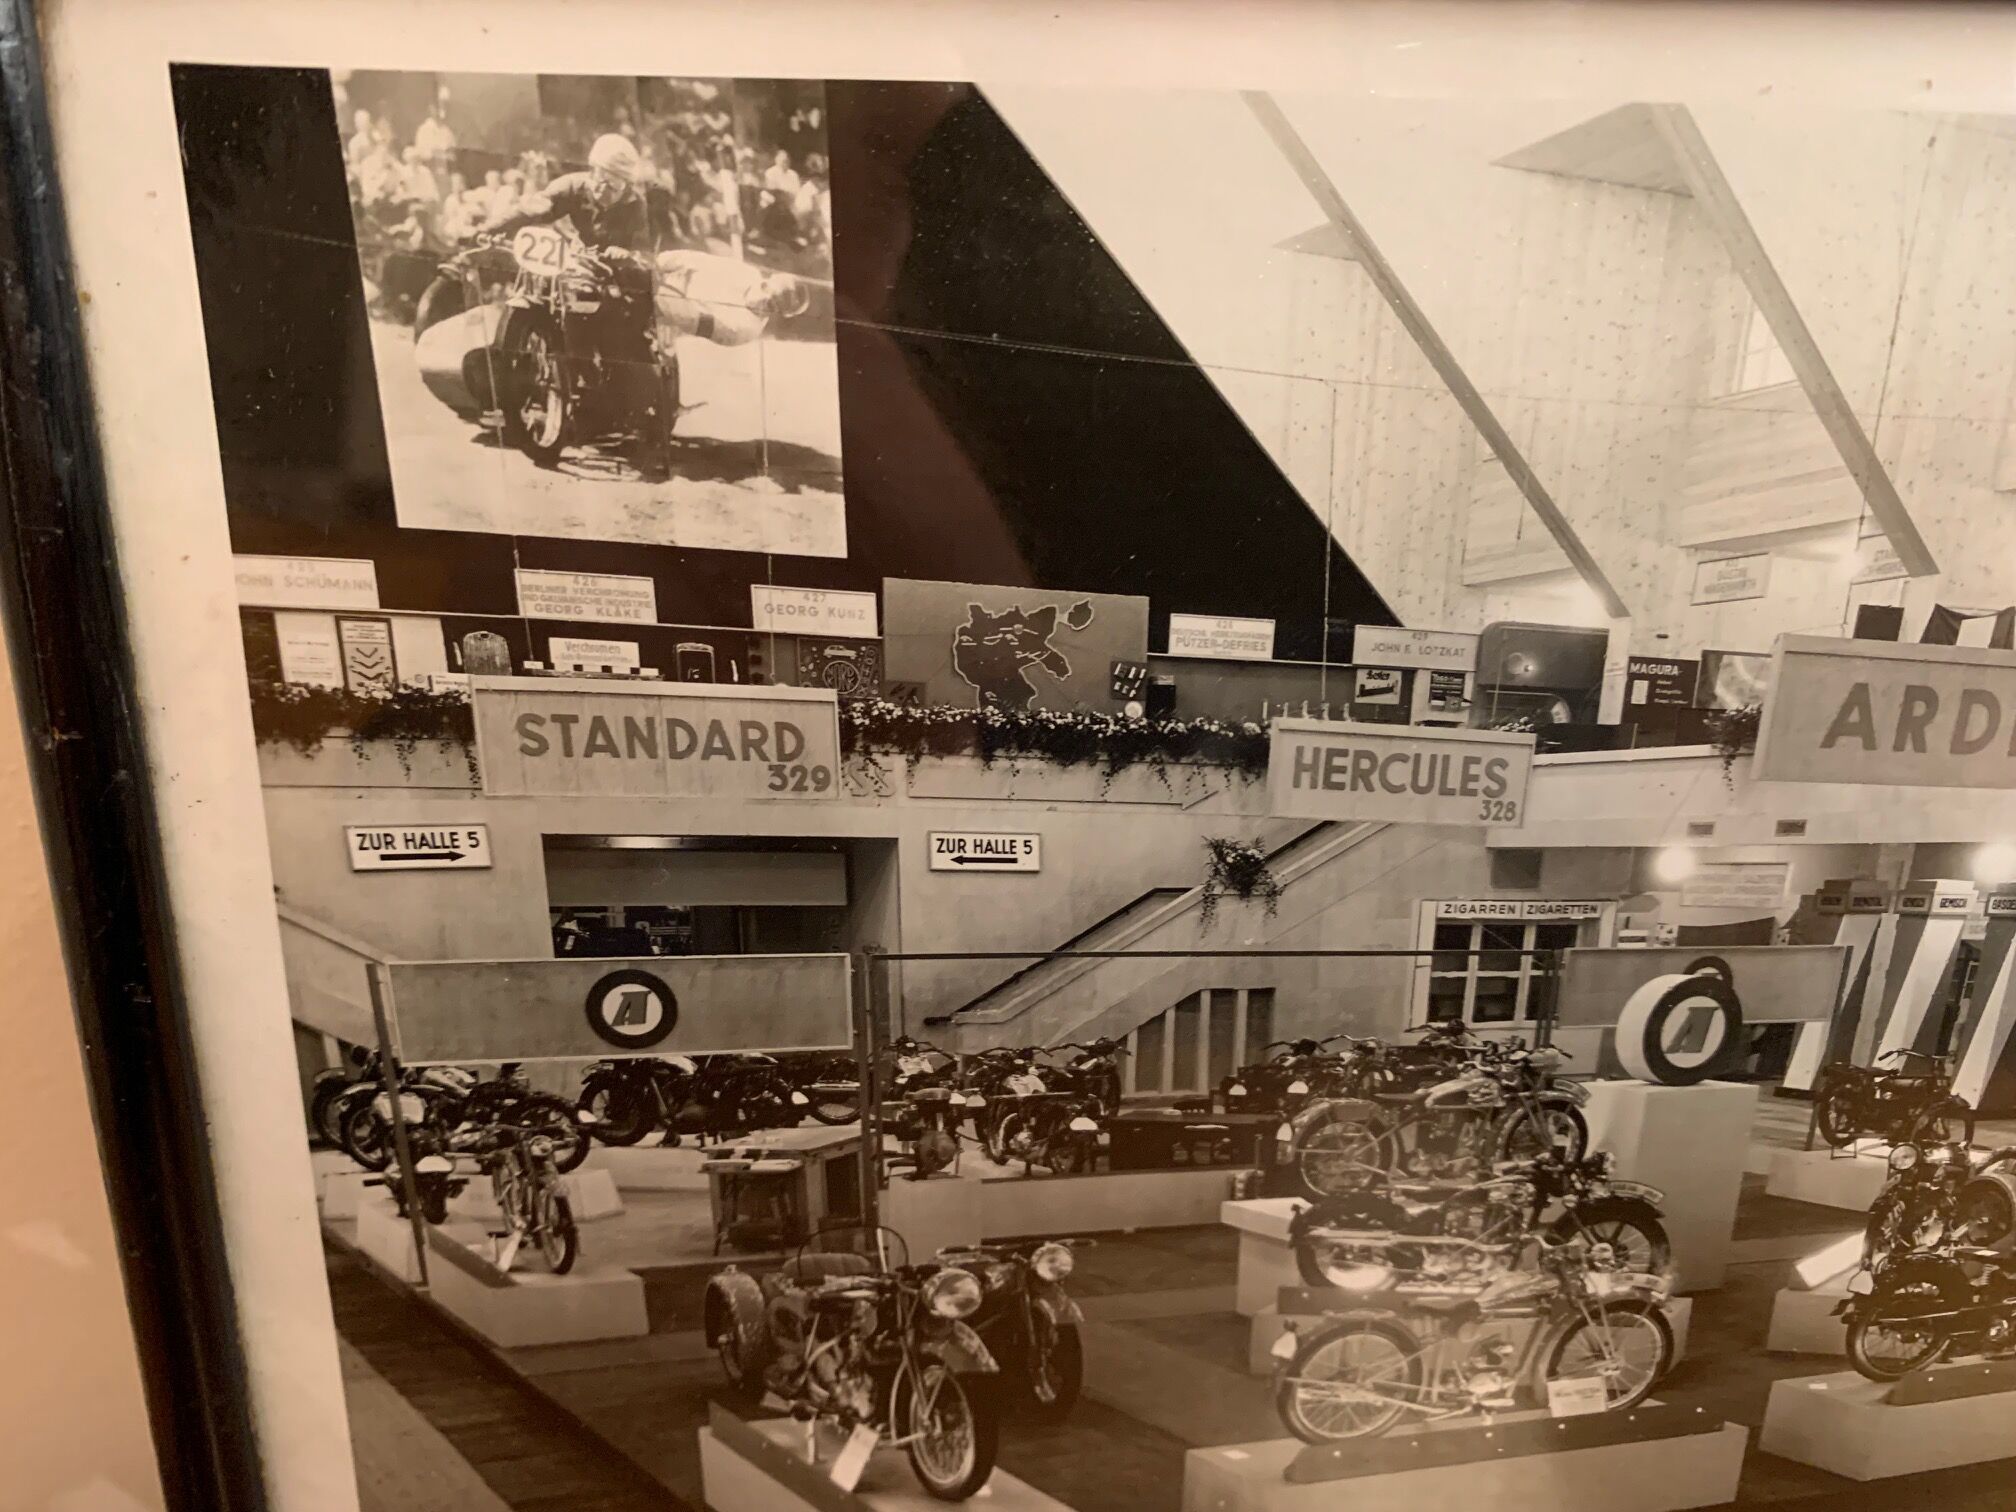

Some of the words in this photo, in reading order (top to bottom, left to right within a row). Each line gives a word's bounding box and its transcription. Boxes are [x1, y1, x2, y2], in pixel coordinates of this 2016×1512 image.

[534, 603, 584, 615] GEORG
[764, 603, 819, 617] GEORG
[827, 606, 866, 620] KUNZ
[1371, 642, 1401, 654] JOHN
[1629, 662, 1679, 676] MAGURA
[515, 712, 806, 763] STANDARD
[767, 763, 832, 793] 329
[1292, 745, 1510, 799] HERCULES
[1478, 800, 1517, 822] 328
[356, 832, 397, 851] ZUR
[403, 831, 461, 850] HALLE
[467, 831, 480, 849] 5
[936, 838, 967, 854] ZUR
[973, 838, 1017, 855] HALLE
[1023, 840, 1033, 855] 5
[1443, 903, 1516, 915] ZIGARREN
[1526, 904, 1598, 915] ZIGARETTEN
